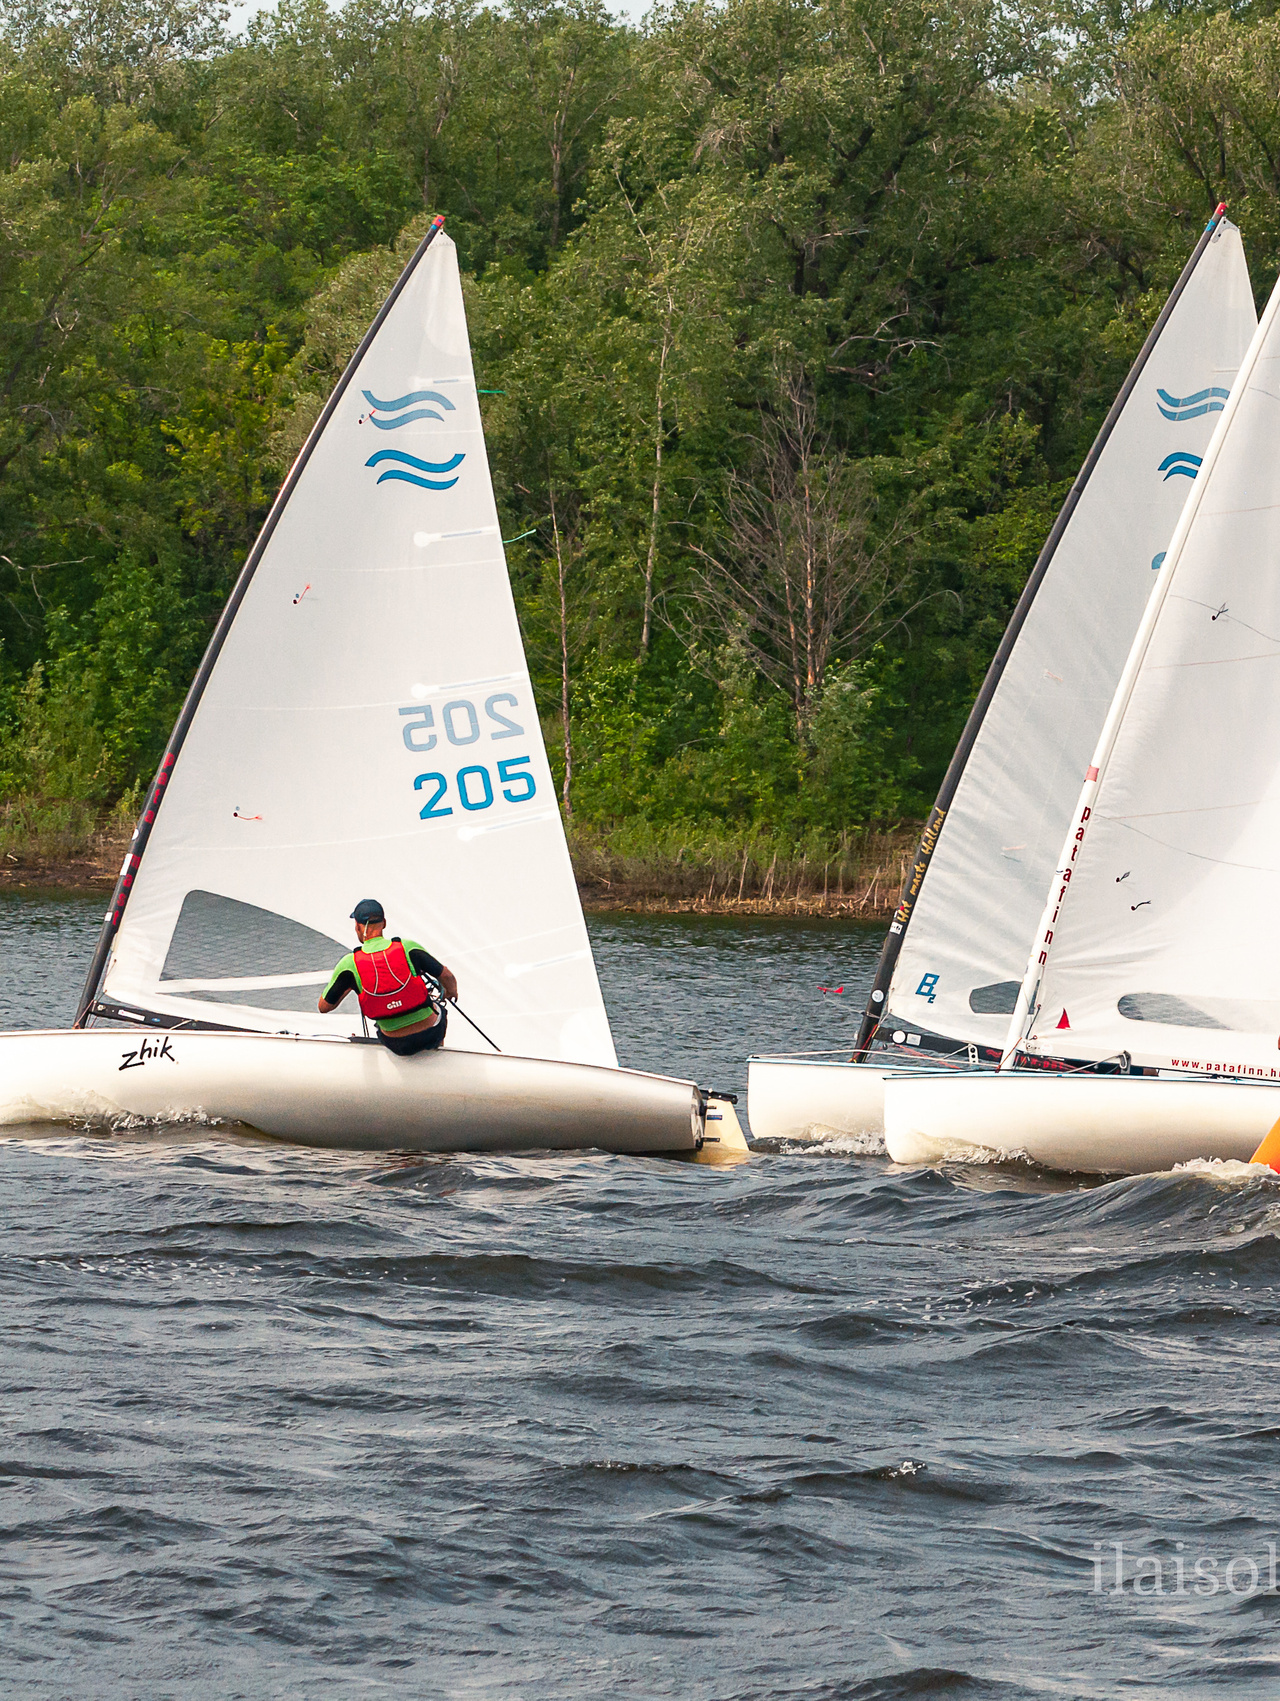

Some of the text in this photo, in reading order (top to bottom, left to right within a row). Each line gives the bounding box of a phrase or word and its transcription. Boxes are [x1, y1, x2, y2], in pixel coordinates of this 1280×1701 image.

[413, 755, 537, 820] 205
[921, 806, 946, 855] Holland
[1038, 806, 1092, 966] patafinn
[386, 1000, 403, 1010] Gill
[118, 1036, 175, 1071] zhik
